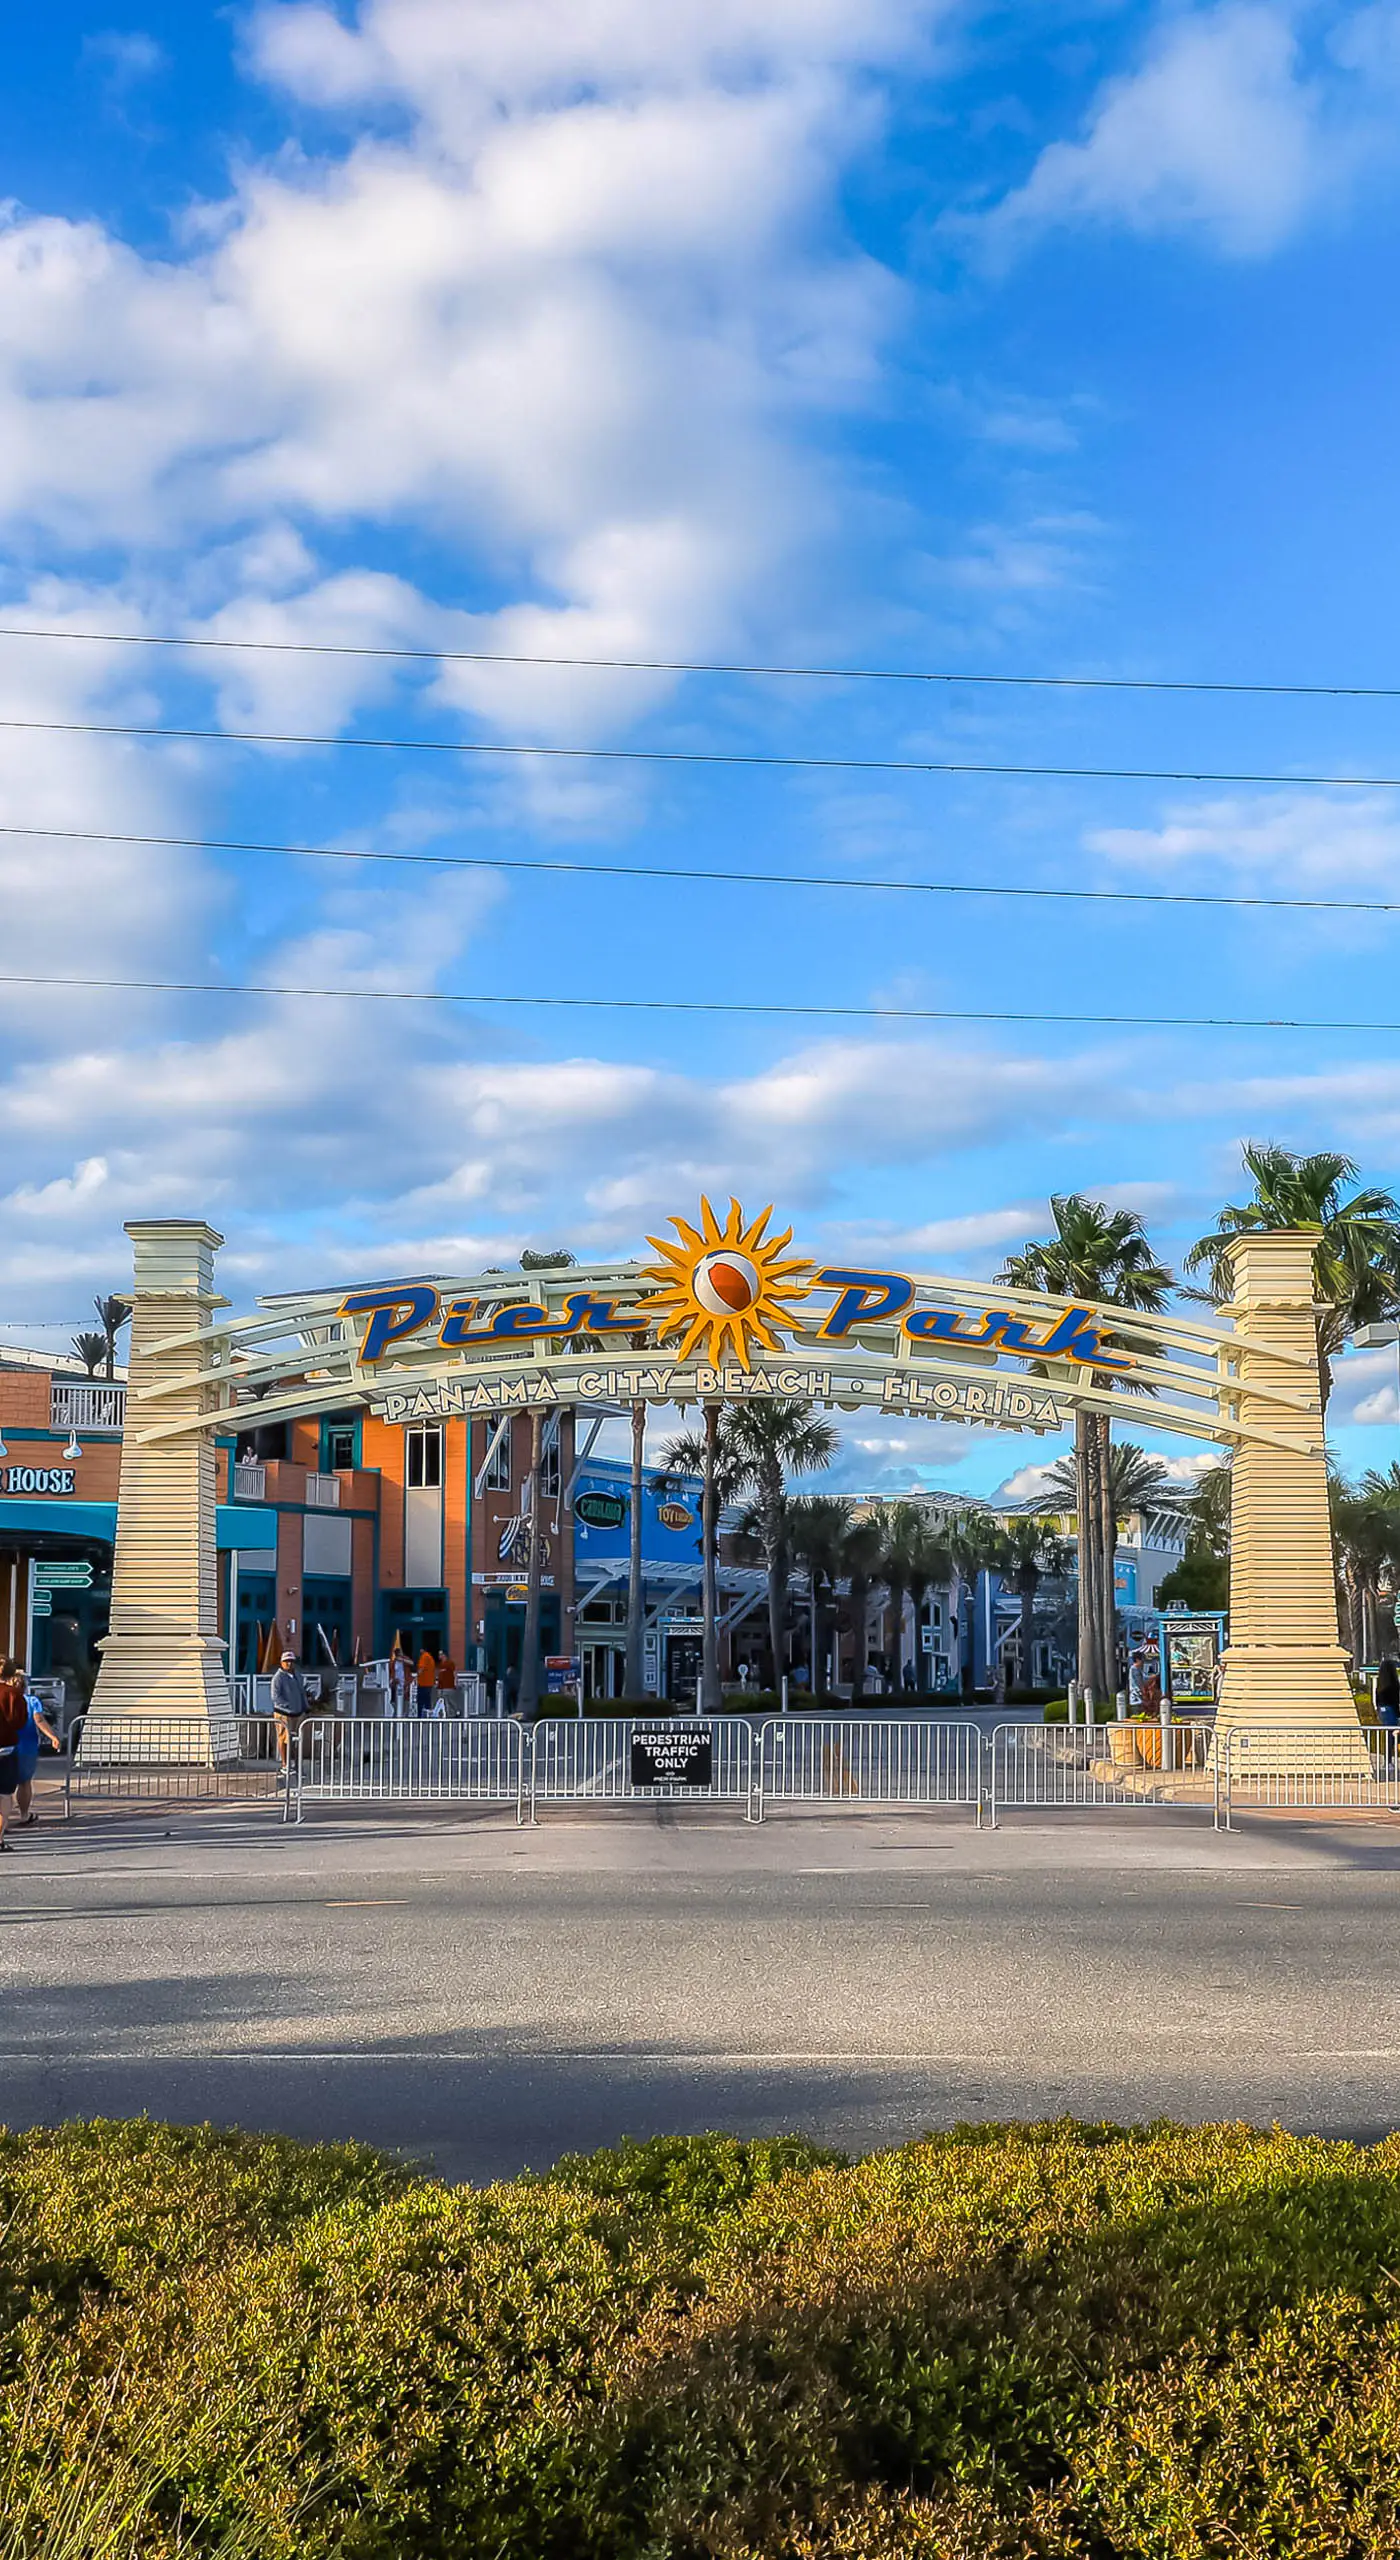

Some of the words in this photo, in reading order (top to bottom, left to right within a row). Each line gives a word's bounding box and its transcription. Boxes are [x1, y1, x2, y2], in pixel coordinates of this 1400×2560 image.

[336, 1283, 652, 1366] Pier
[808, 1266, 1138, 1371] Park
[386, 1376, 558, 1422] PANAMA
[578, 1367, 676, 1398] CITY
[696, 1366, 831, 1397] BEACH
[883, 1376, 1061, 1424] FLORIDA
[6, 1466, 75, 1494] HOUSE
[632, 1734, 710, 1745] PEDESTRIAN
[644, 1746, 698, 1757] TRAFFIC
[654, 1758, 688, 1768] ONLY
